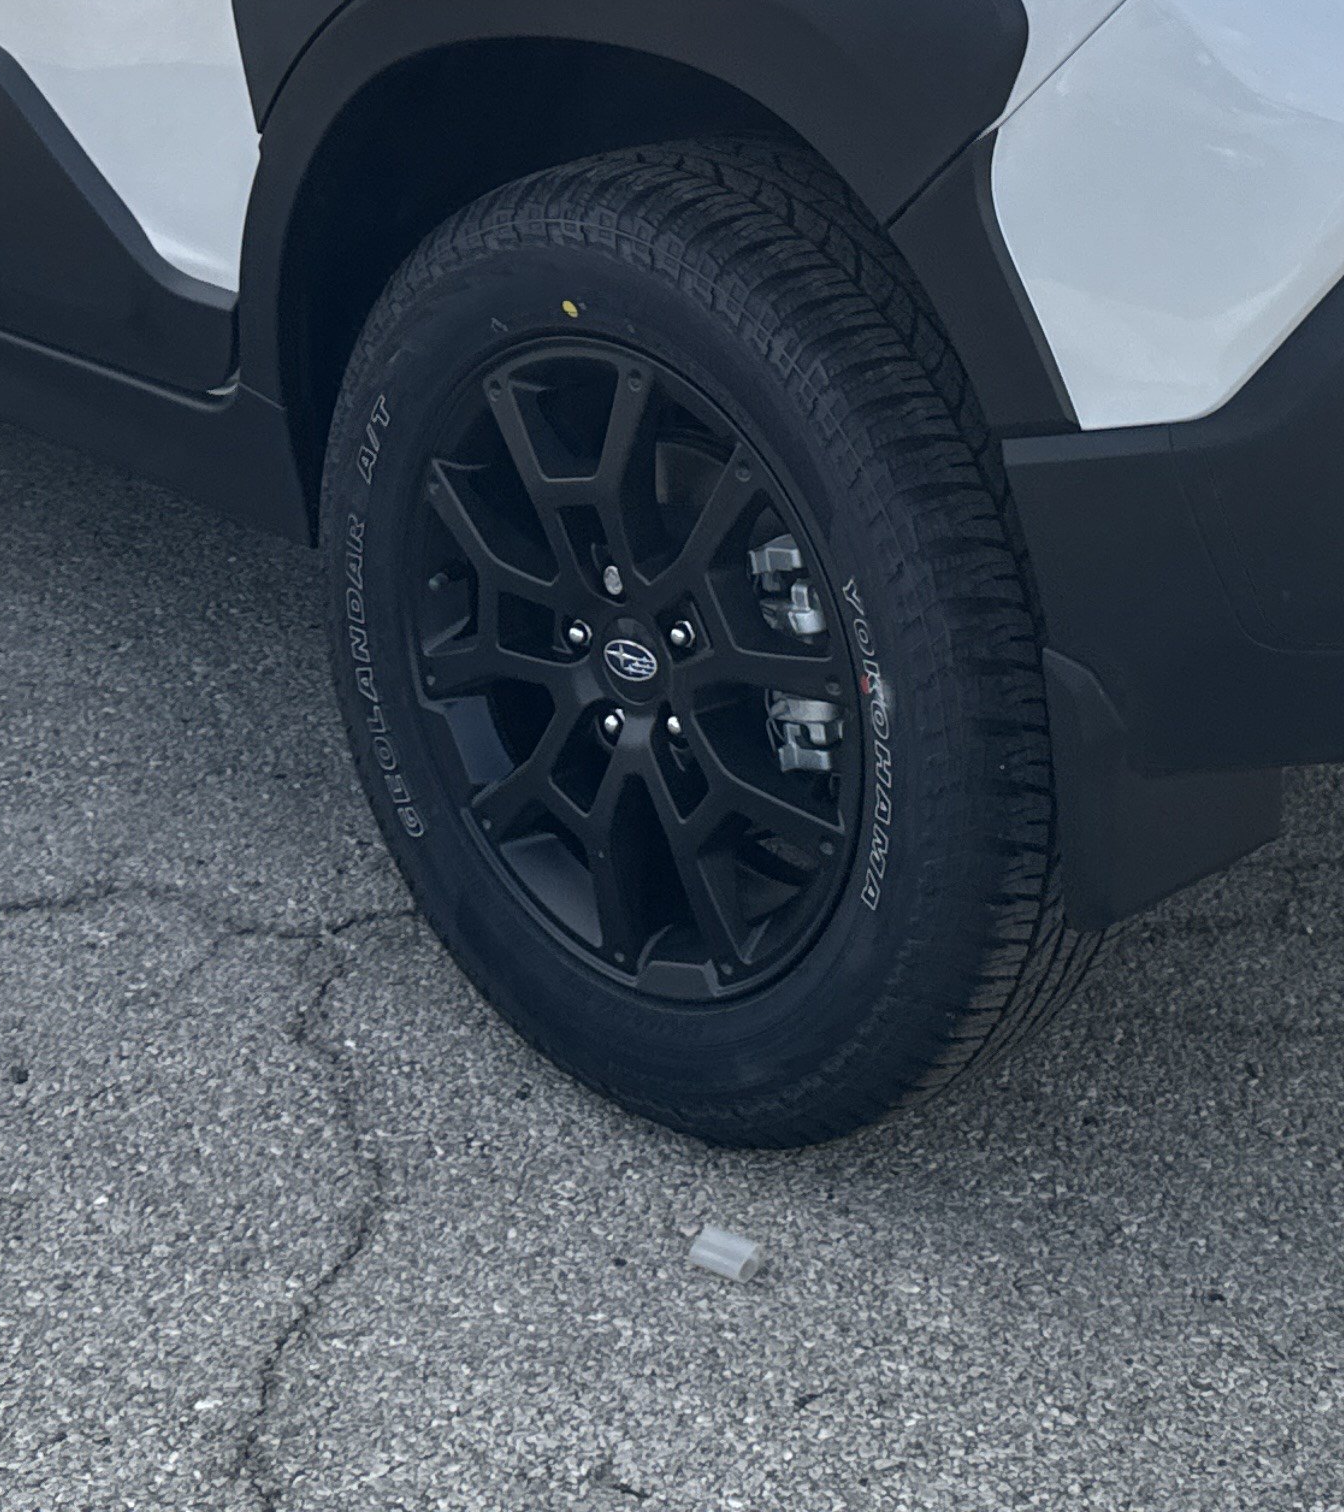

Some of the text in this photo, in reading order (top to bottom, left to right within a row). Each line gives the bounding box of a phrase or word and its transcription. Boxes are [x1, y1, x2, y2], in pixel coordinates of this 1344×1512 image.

[346, 394, 426, 838] GEOLANDAR A/T
[842, 578, 892, 912] YOKOHAMA
